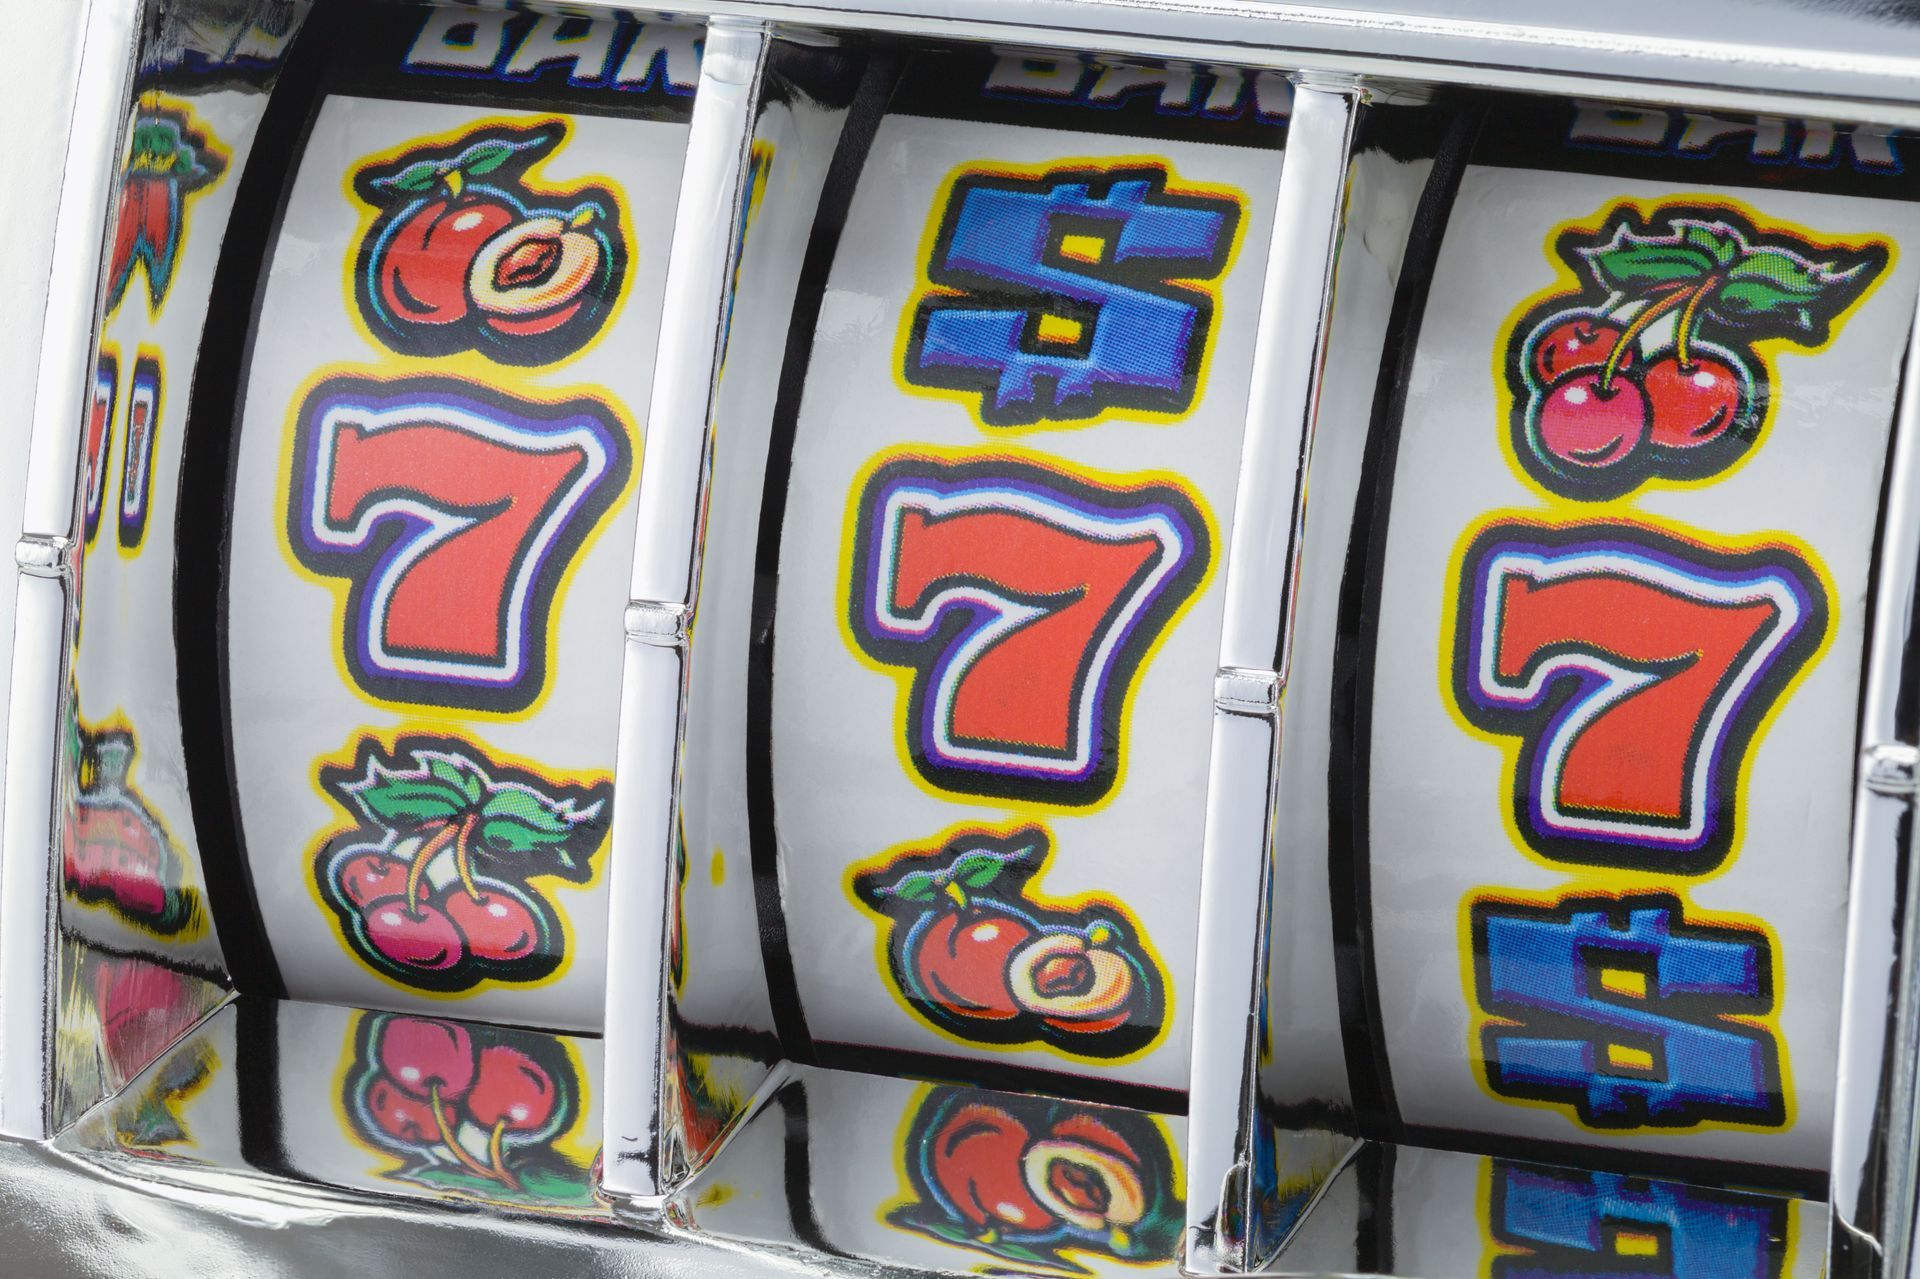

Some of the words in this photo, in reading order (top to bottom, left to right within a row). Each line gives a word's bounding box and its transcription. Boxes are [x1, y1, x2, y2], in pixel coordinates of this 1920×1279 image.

[288, 373, 632, 713] 7
[849, 454, 1206, 807] 7
[1453, 518, 1828, 876] 7
